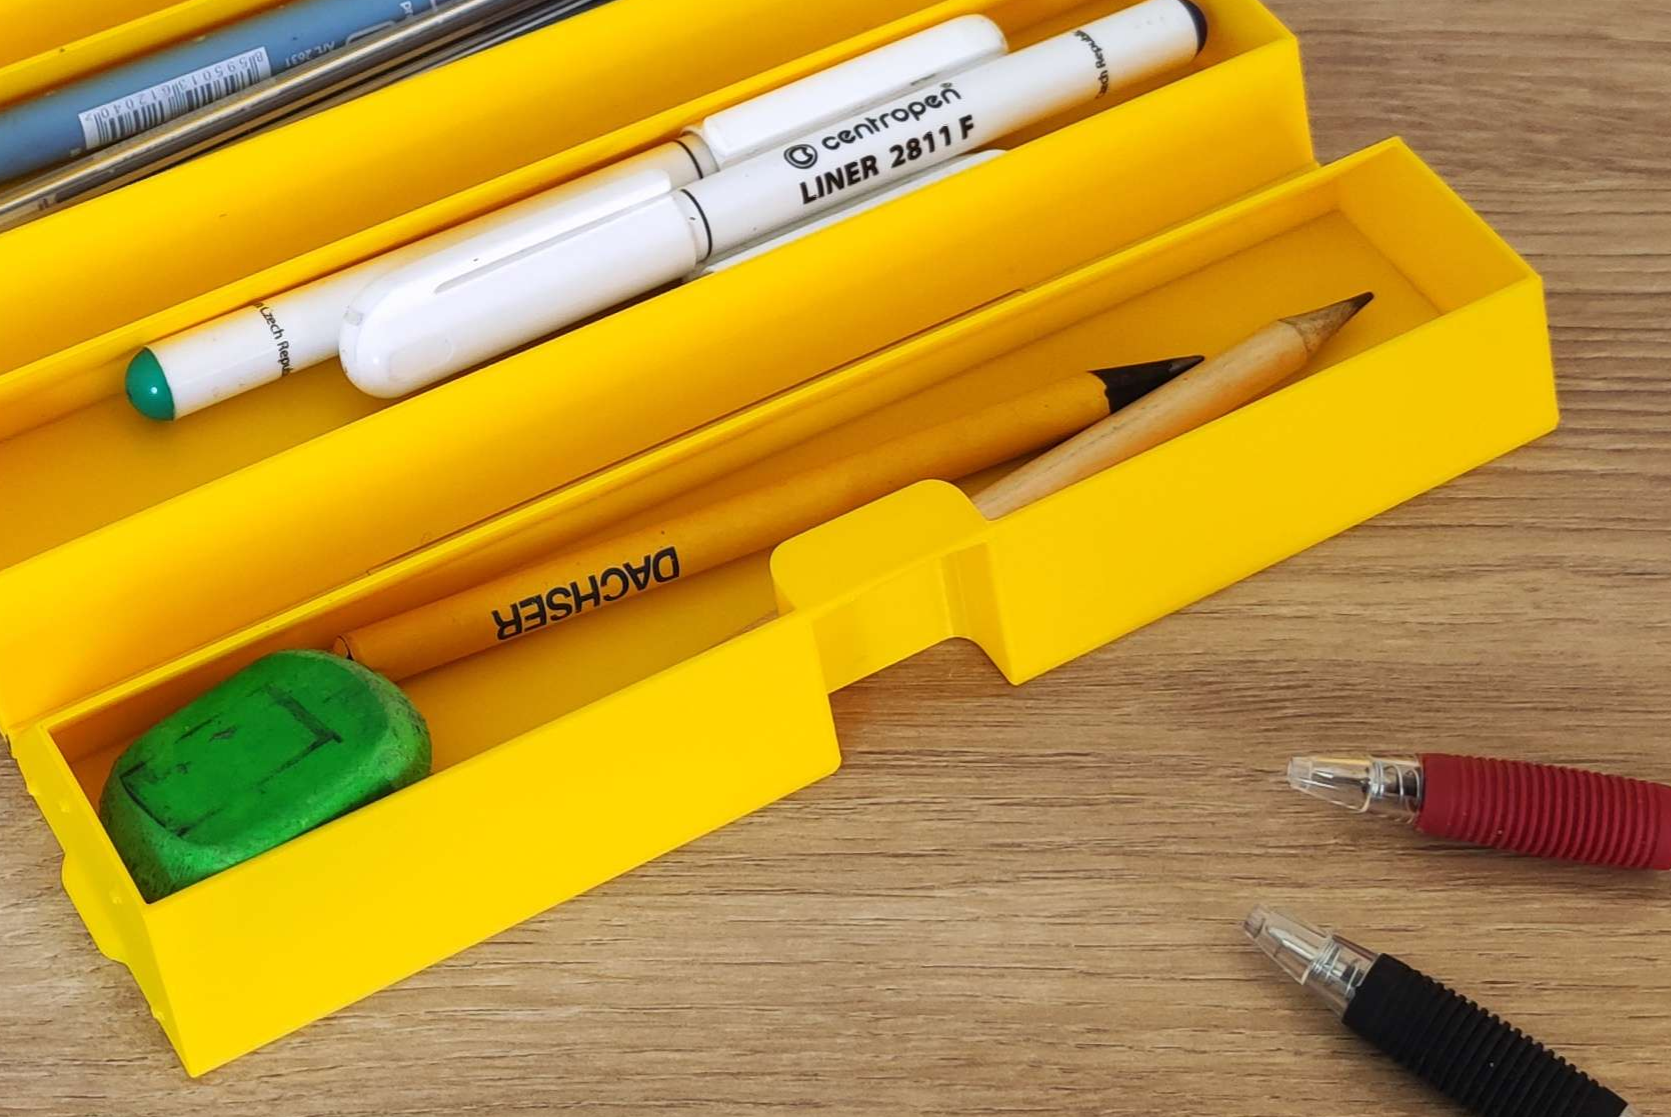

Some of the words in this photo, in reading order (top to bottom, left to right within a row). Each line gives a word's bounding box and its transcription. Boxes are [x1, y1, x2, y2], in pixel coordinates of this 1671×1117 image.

[798, 154, 880, 205] LINER
[889, 125, 952, 169] 2811
[958, 114, 975, 141] F
[259, 306, 285, 341] Czech
[491, 545, 681, 642] DACHSER
